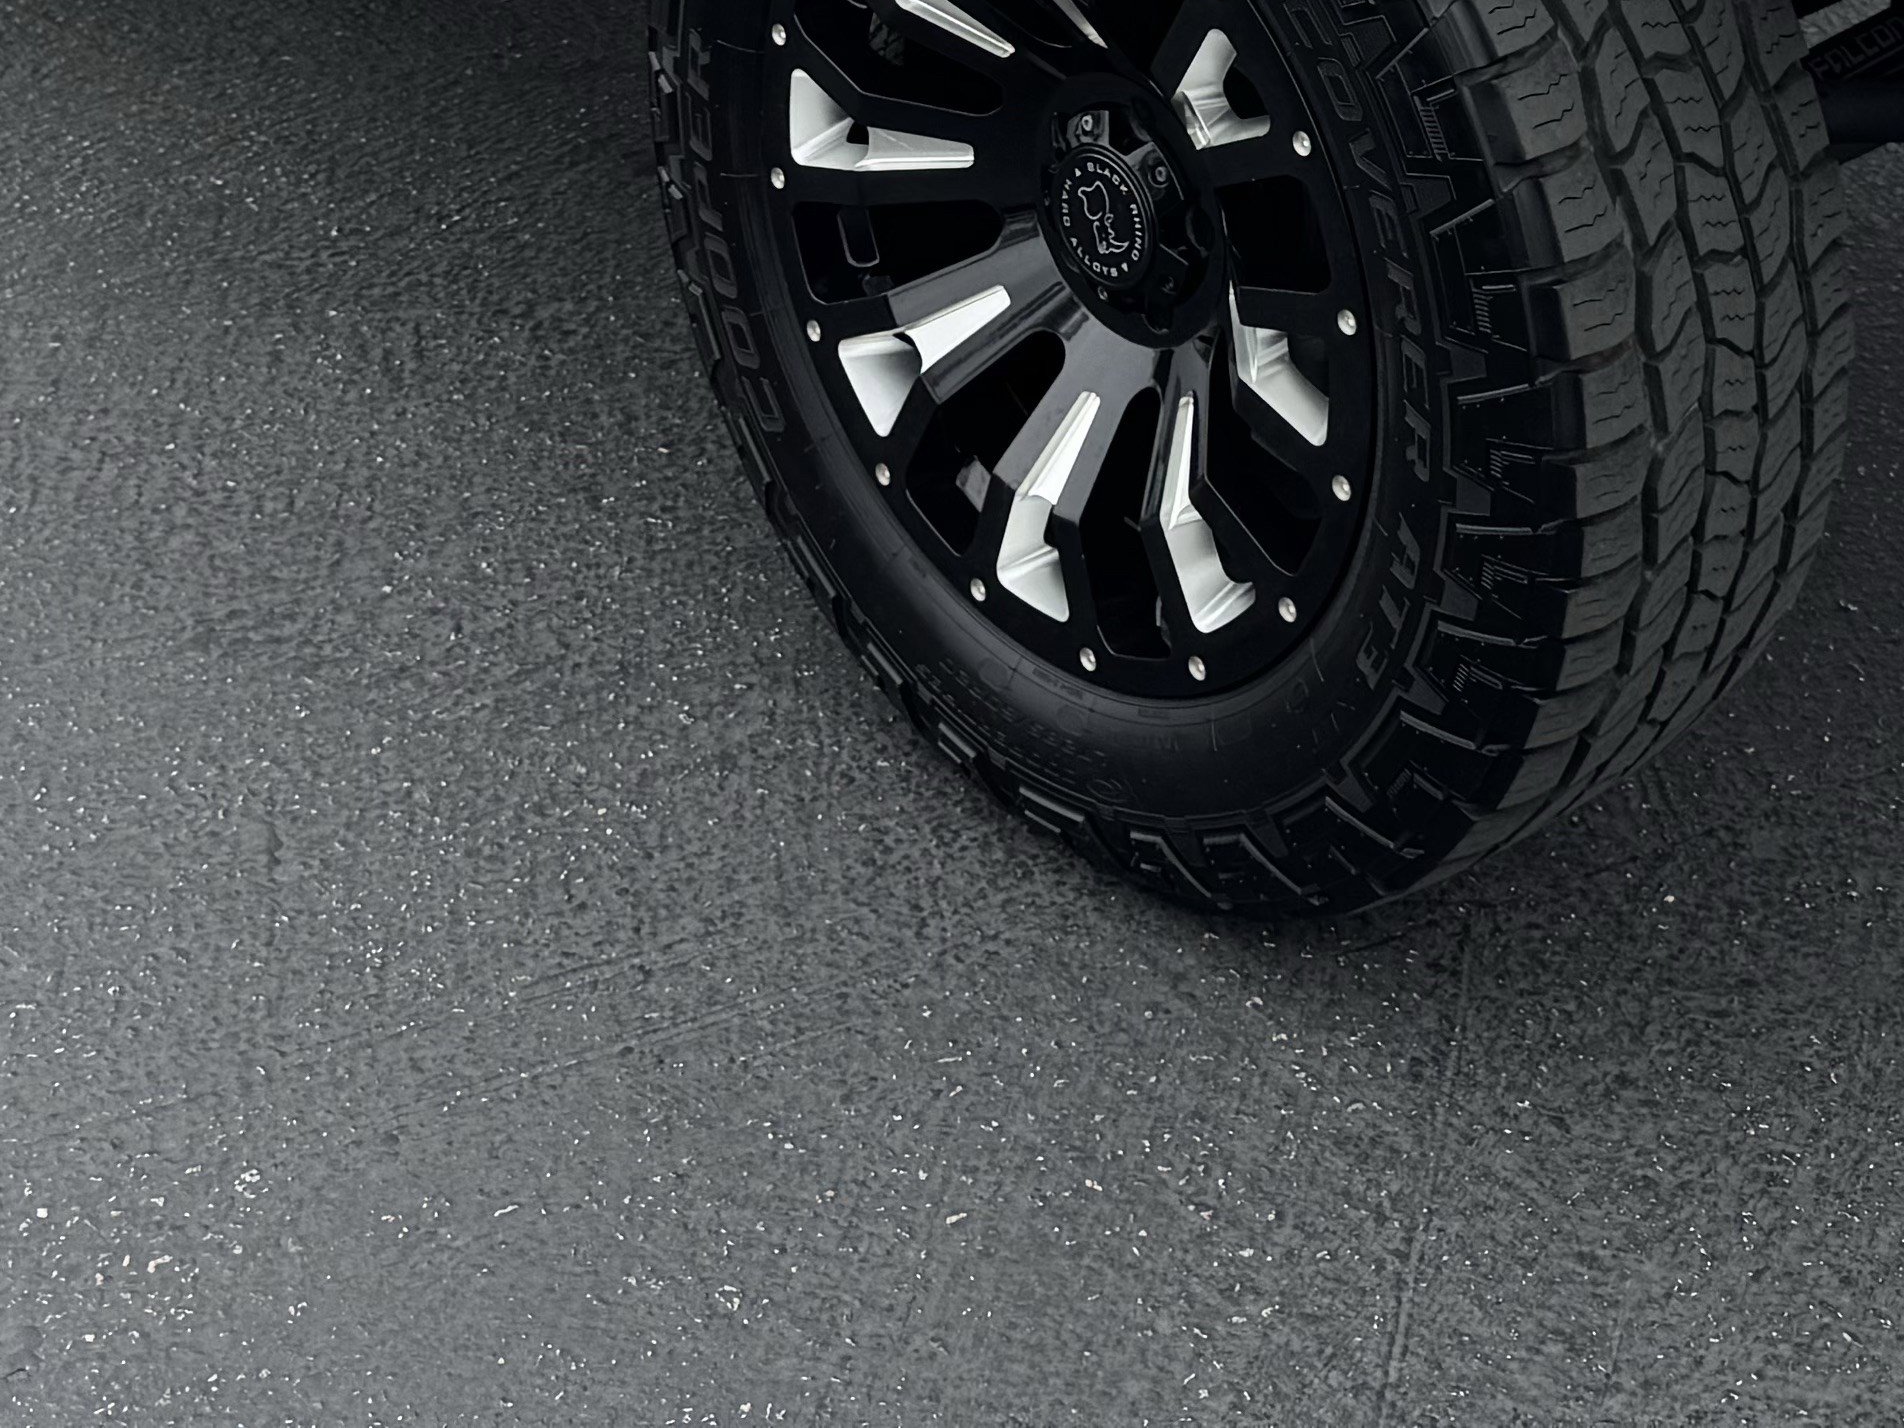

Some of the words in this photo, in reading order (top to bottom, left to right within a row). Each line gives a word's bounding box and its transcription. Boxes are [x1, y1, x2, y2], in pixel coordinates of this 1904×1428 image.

[687, 27, 785, 433] COOPER
[1086, 161, 1129, 196] BLACK
[1128, 203, 1143, 262] RHINO
[1356, 512, 1422, 691] AT3
